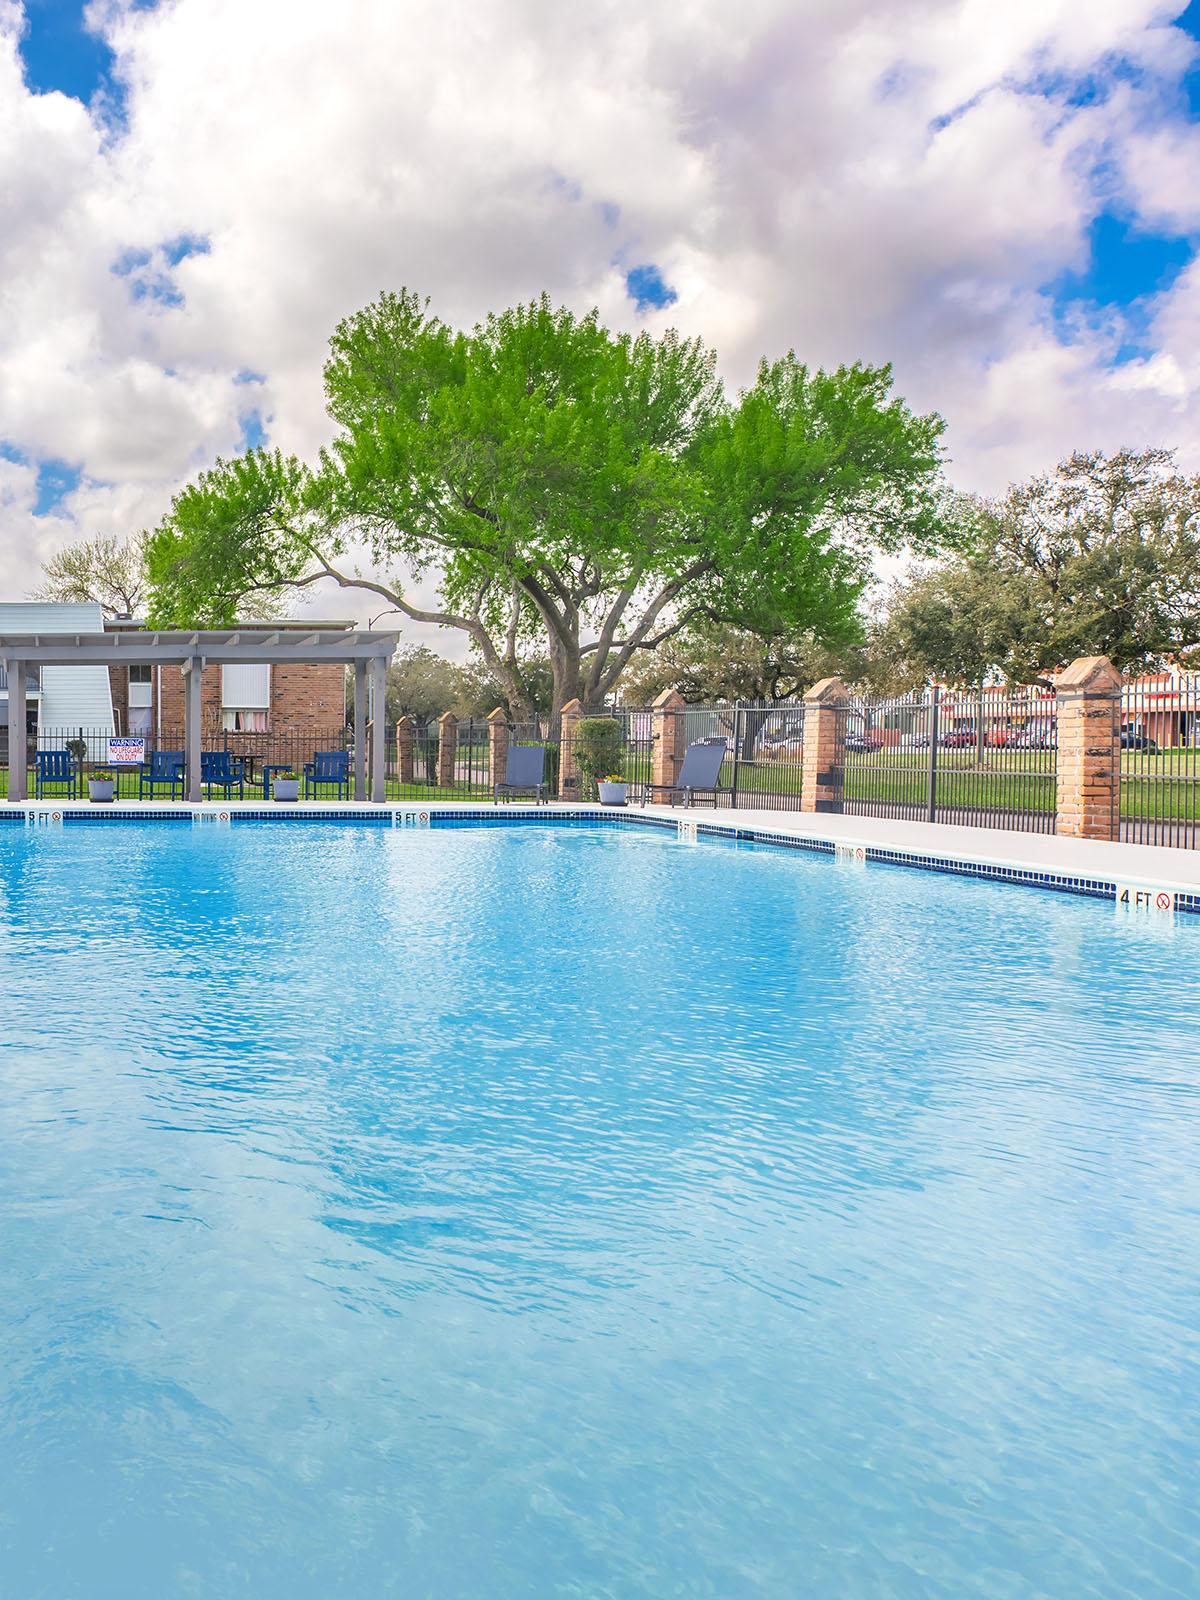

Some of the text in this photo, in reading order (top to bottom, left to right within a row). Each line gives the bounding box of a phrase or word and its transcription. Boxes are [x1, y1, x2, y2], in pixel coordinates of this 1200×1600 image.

[29, 812, 49, 822] 5 FT
[396, 812, 416, 822] 5 FT
[1120, 890, 1152, 906] 4 FT
